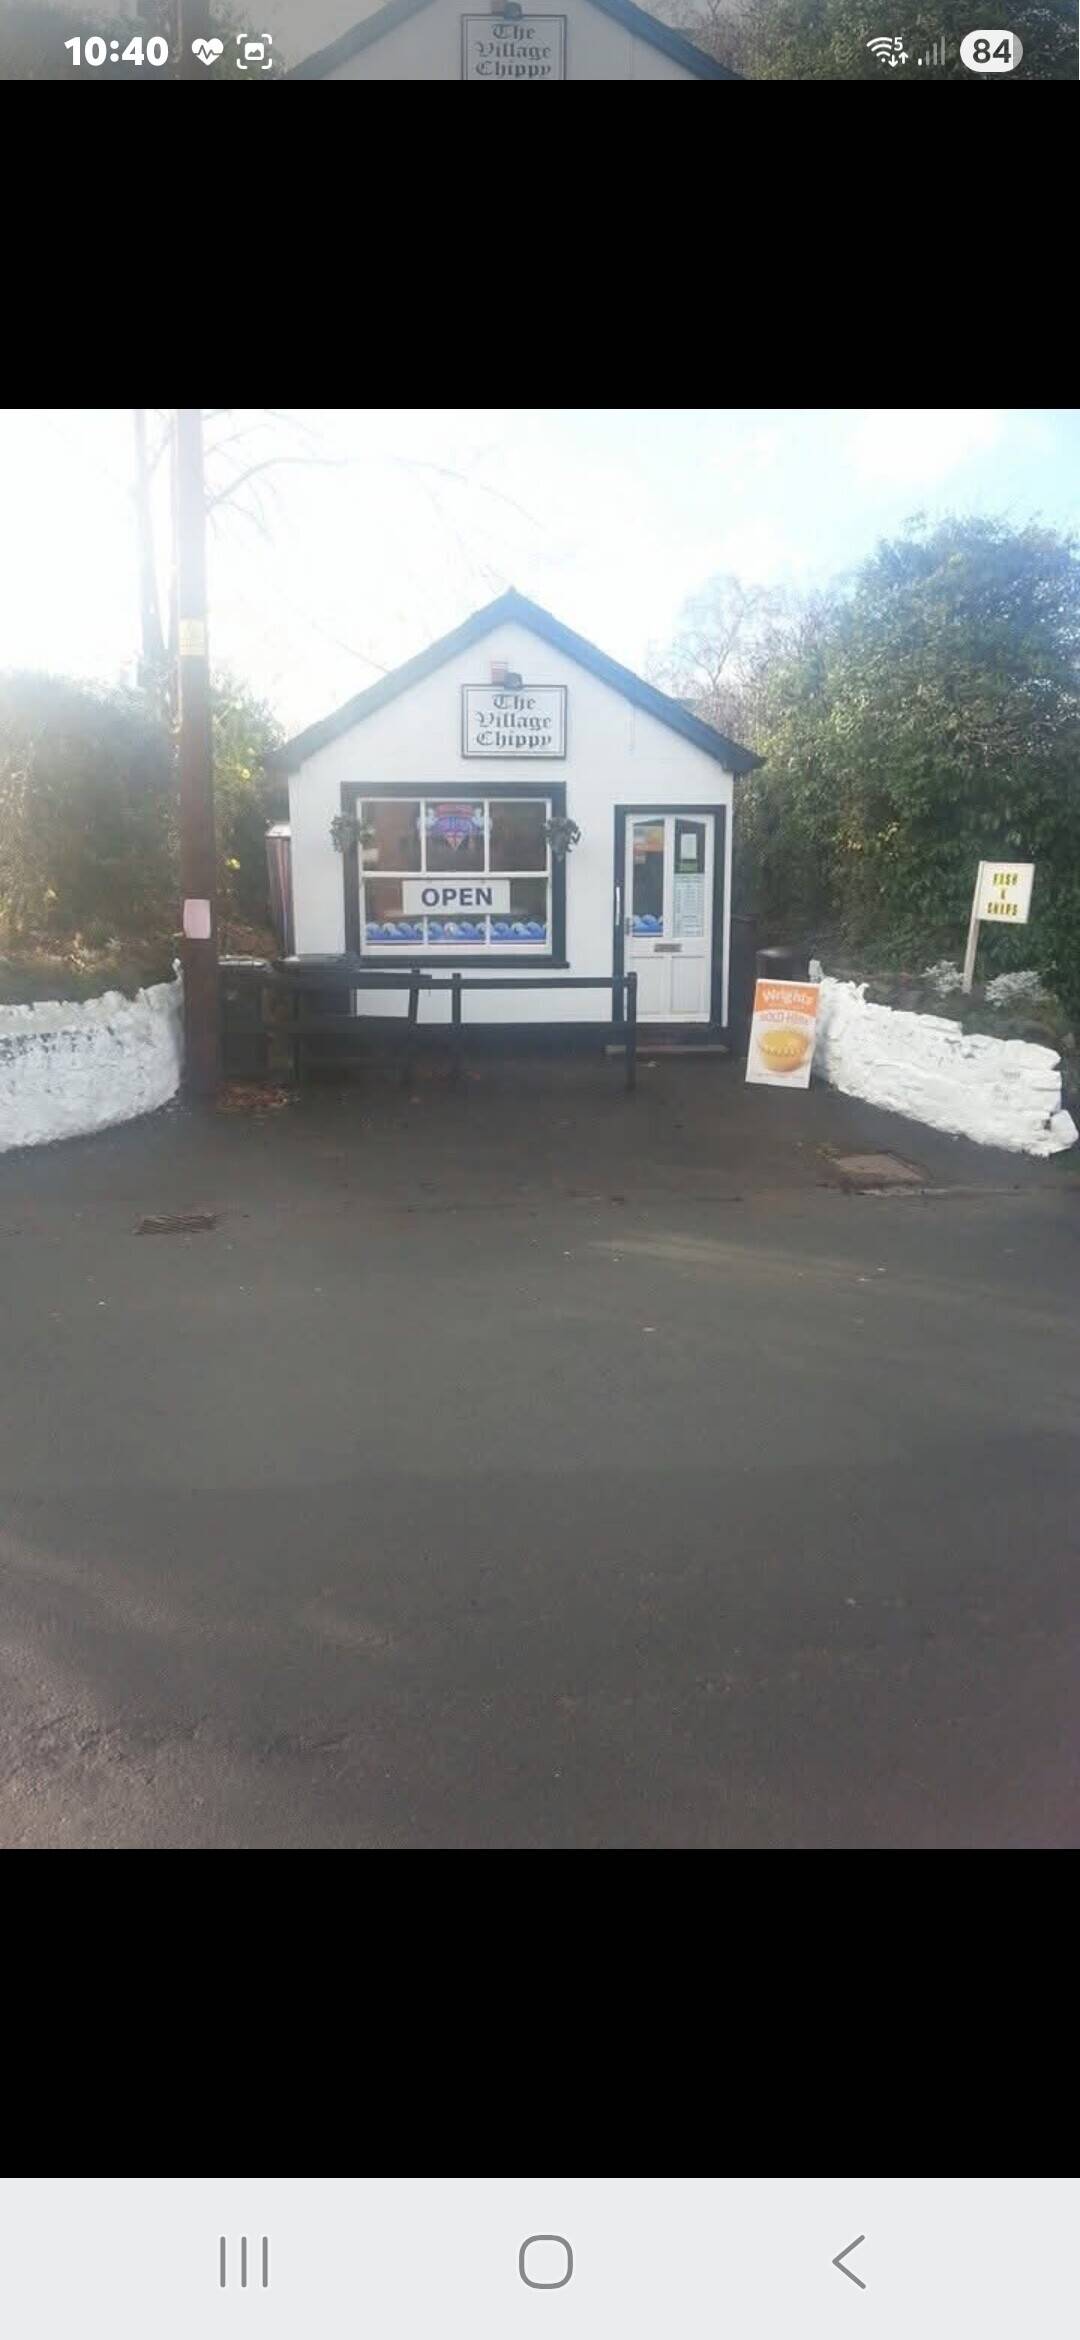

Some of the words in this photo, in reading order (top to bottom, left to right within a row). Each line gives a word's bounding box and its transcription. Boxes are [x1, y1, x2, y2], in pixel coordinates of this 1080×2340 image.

[492, 23, 536, 41] The
[475, 41, 552, 61] Village
[475, 60, 552, 79] Chippy
[492, 694, 536, 711] The
[475, 711, 552, 731] Village
[475, 730, 552, 749] Chippy
[420, 887, 494, 907] OPEN
